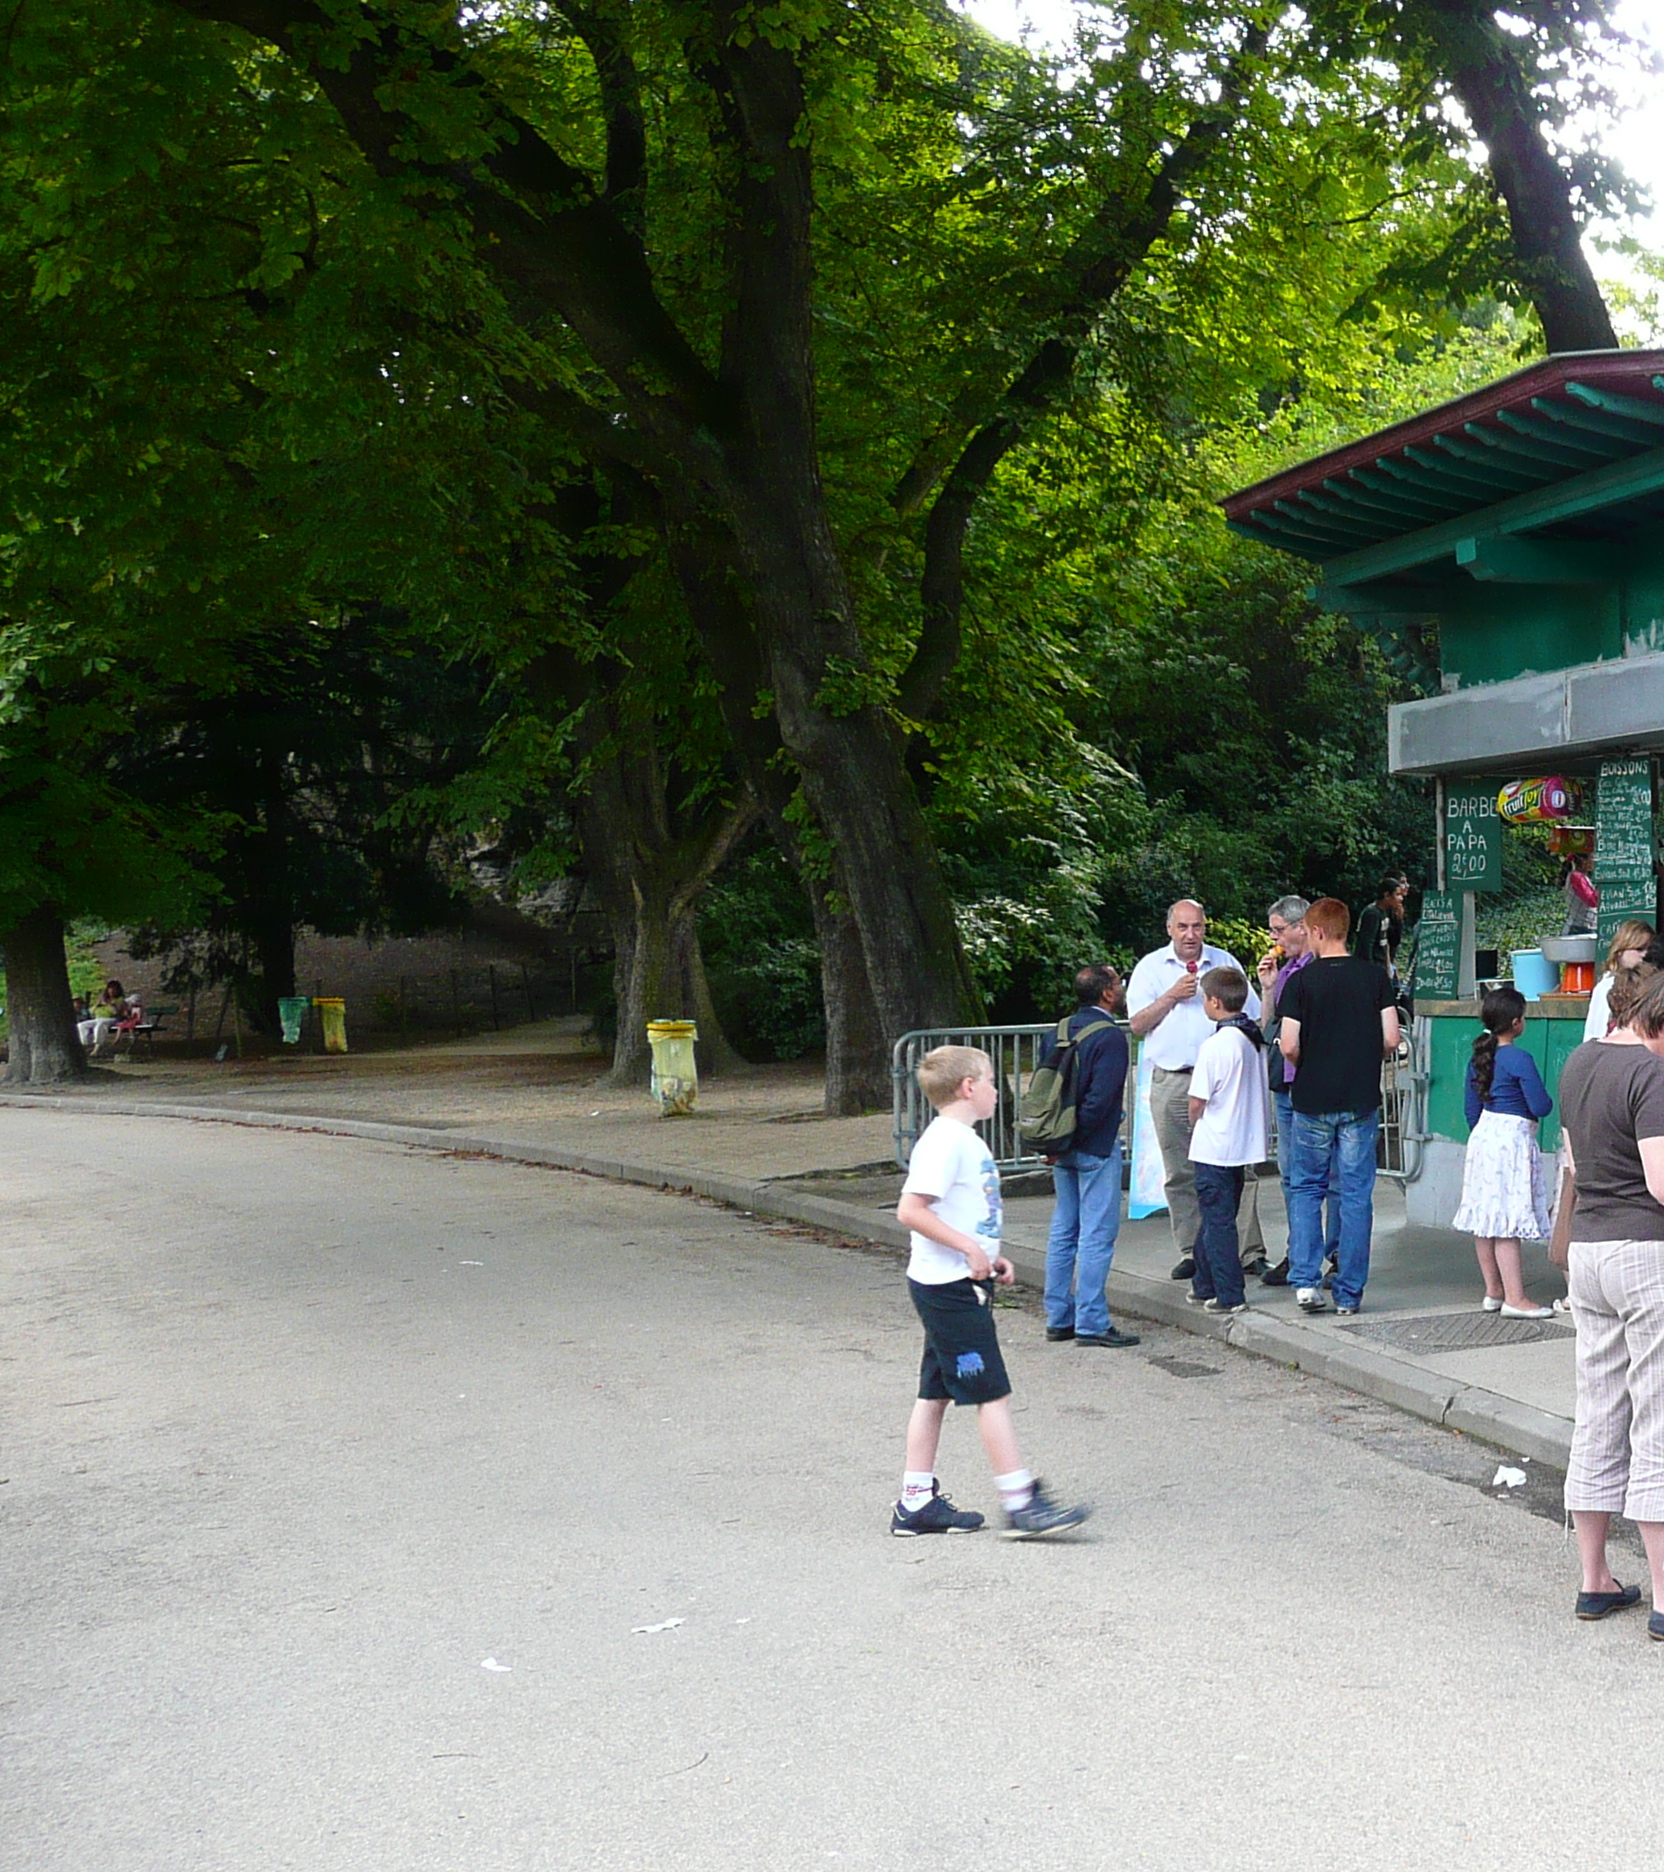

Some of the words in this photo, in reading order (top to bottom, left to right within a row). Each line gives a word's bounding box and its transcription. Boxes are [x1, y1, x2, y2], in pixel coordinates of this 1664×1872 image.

[1600, 761, 1649, 777] BOISSONS
[1447, 797, 1499, 818] BARBE
[1462, 820, 1472, 833] A
[1447, 834, 1487, 850] PAPA
